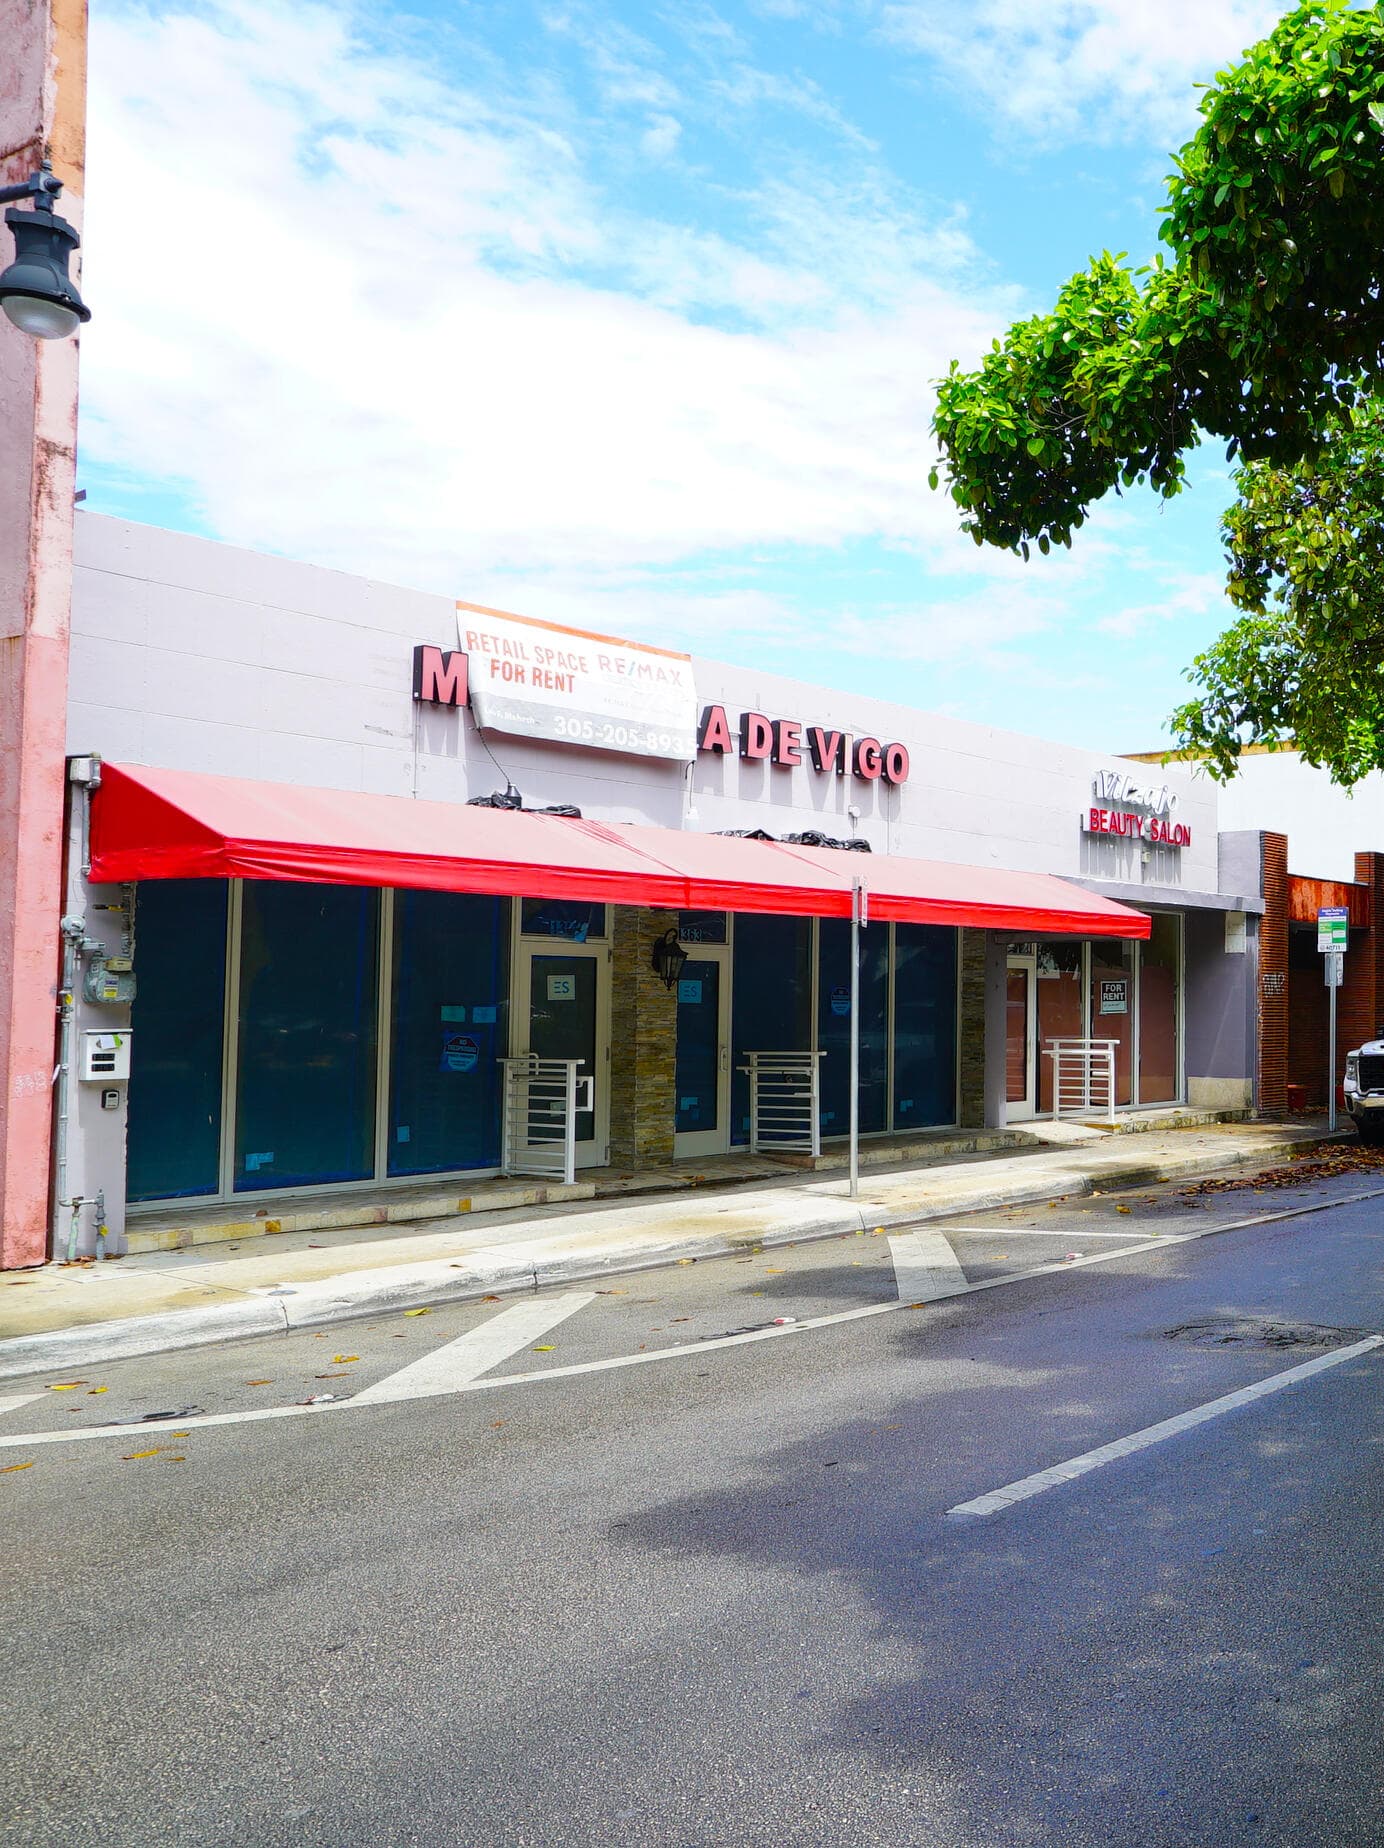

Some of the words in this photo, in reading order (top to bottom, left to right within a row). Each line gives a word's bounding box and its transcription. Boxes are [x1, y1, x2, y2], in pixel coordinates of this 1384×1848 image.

[466, 630, 529, 661] RETAIL
[534, 645, 588, 674] SPACE
[490, 658, 525, 684] FOR
[532, 667, 576, 693] RENT
[598, 654, 682, 687] RE/MAX
[1088, 808, 1144, 838] BEAUTY
[1150, 817, 1192, 847] SALON
[1103, 992, 1125, 1001] RENT
[1105, 983, 1122, 992] FOR
